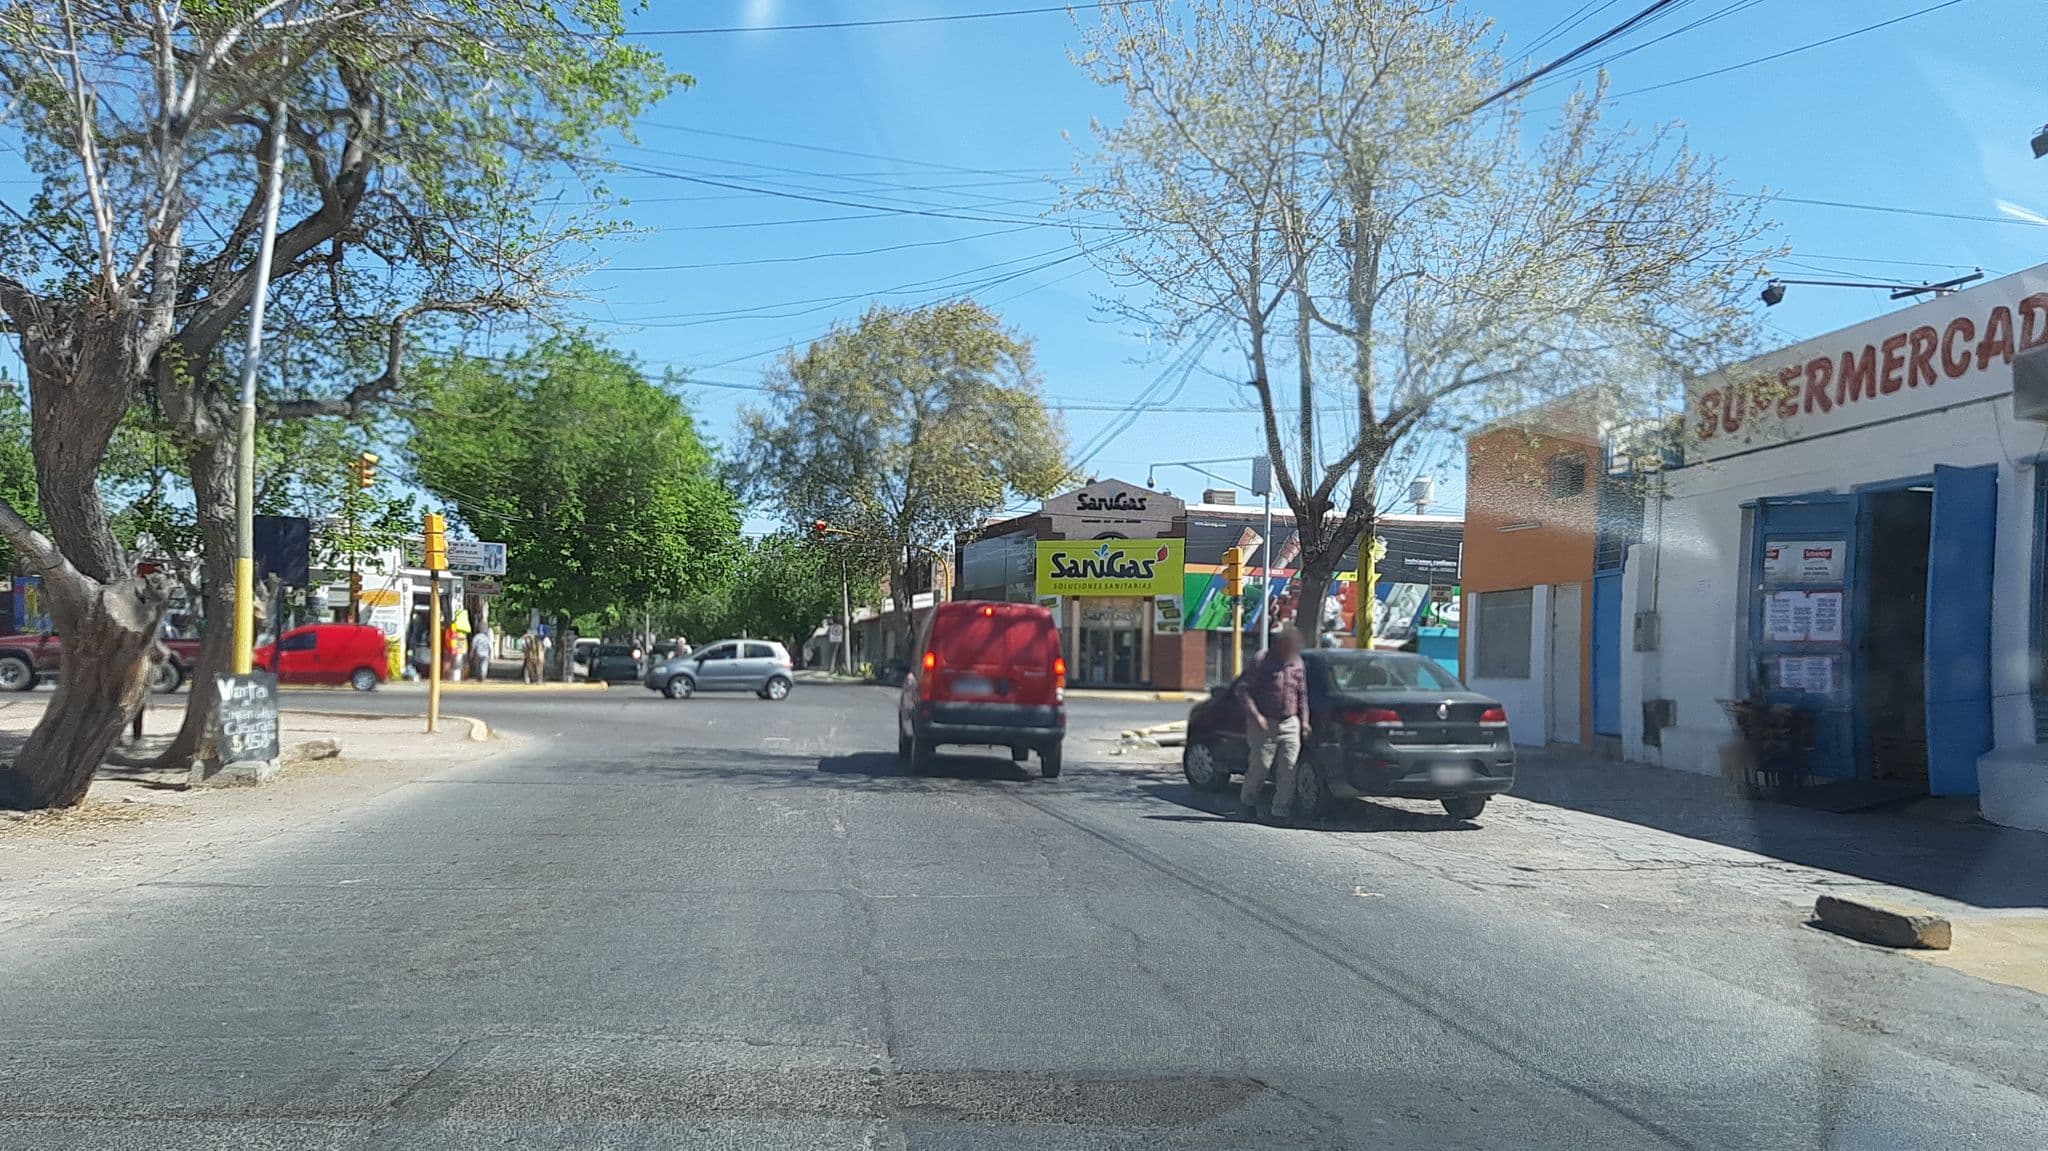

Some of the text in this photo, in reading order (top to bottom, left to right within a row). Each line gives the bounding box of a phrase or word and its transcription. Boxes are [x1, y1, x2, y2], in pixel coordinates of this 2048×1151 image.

[1076, 492, 1147, 511] SaniGas
[1051, 550, 1156, 579] SaniGas
[1053, 582, 1152, 590] SOLUCIONES SANITARIAS
